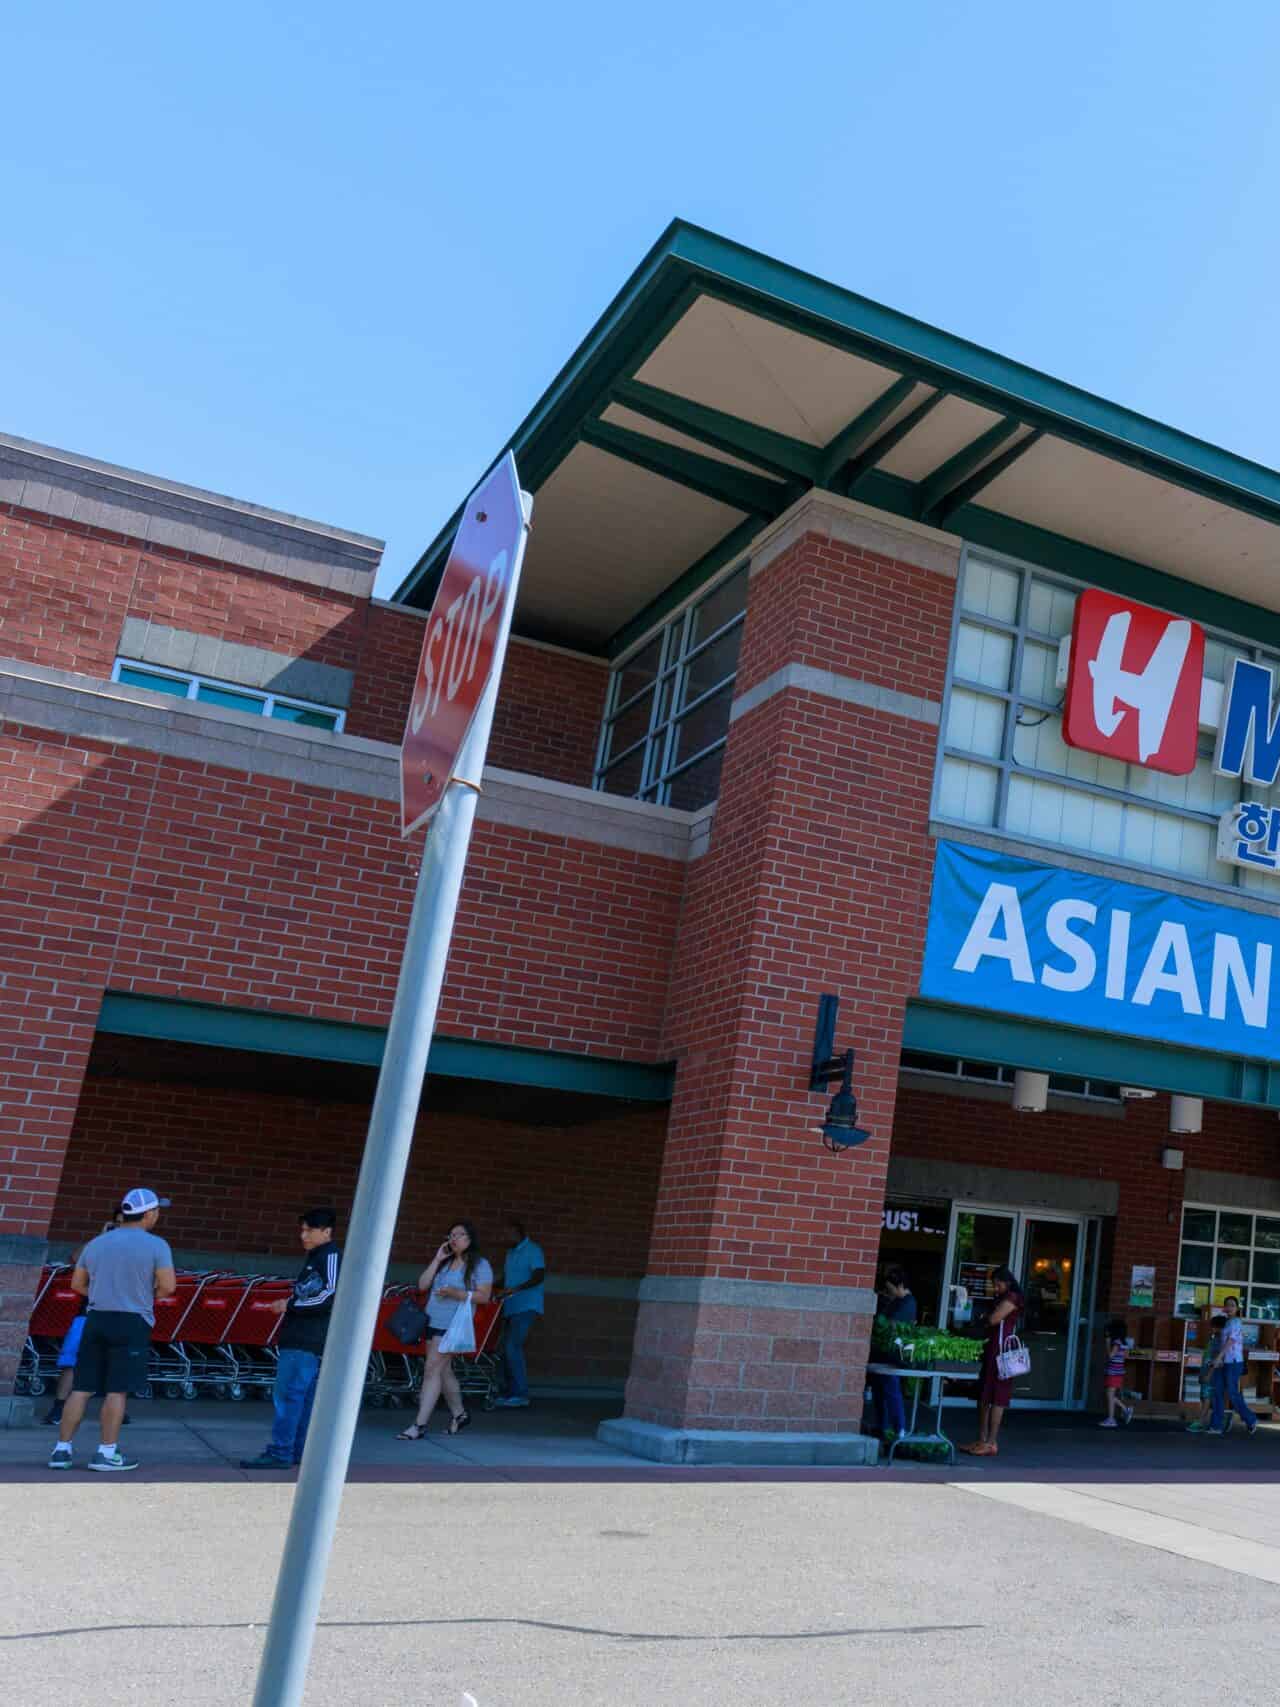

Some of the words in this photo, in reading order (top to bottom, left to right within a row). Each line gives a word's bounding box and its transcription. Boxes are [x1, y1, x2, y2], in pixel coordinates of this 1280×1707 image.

[412, 549, 508, 736] STOP
[1087, 610, 1191, 764] H
[952, 882, 1273, 1029] ASIAN
